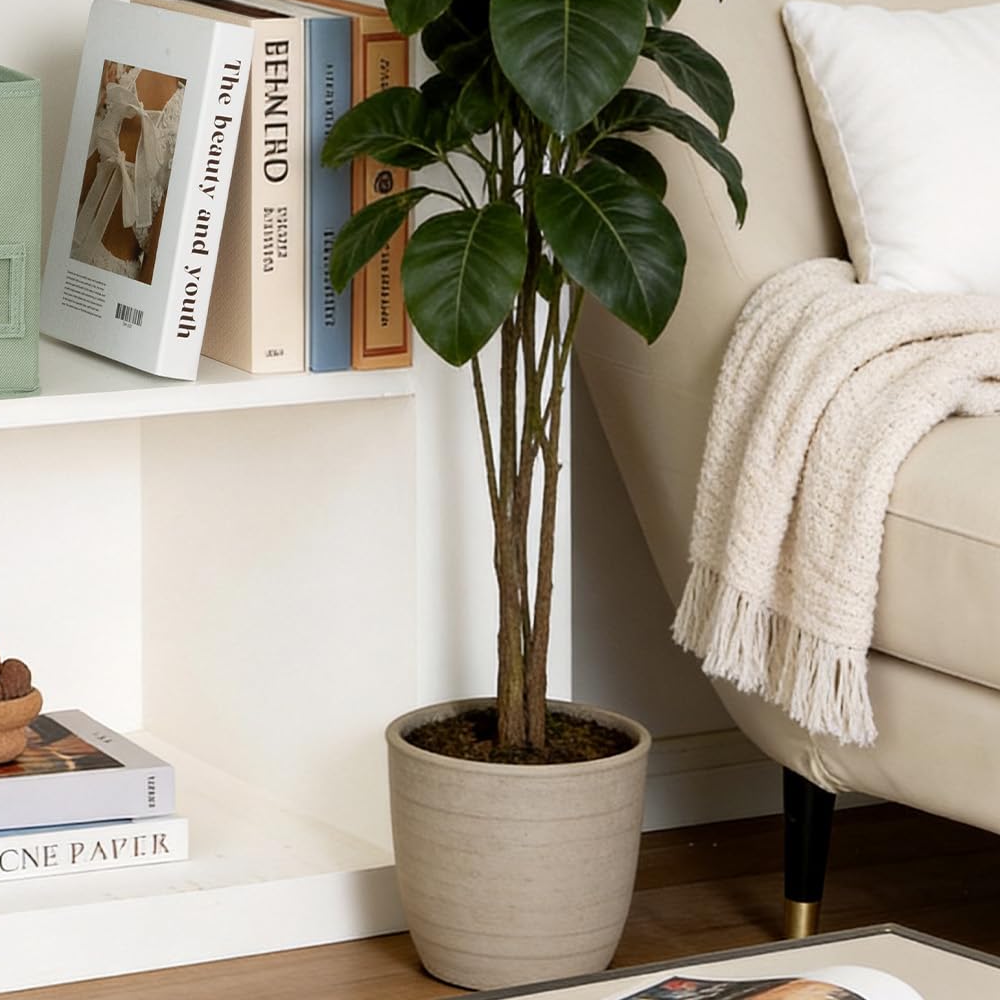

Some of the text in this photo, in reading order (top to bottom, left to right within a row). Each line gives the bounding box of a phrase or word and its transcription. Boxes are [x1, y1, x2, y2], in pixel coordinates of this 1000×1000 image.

[176, 59, 241, 339] The beauty and youth
